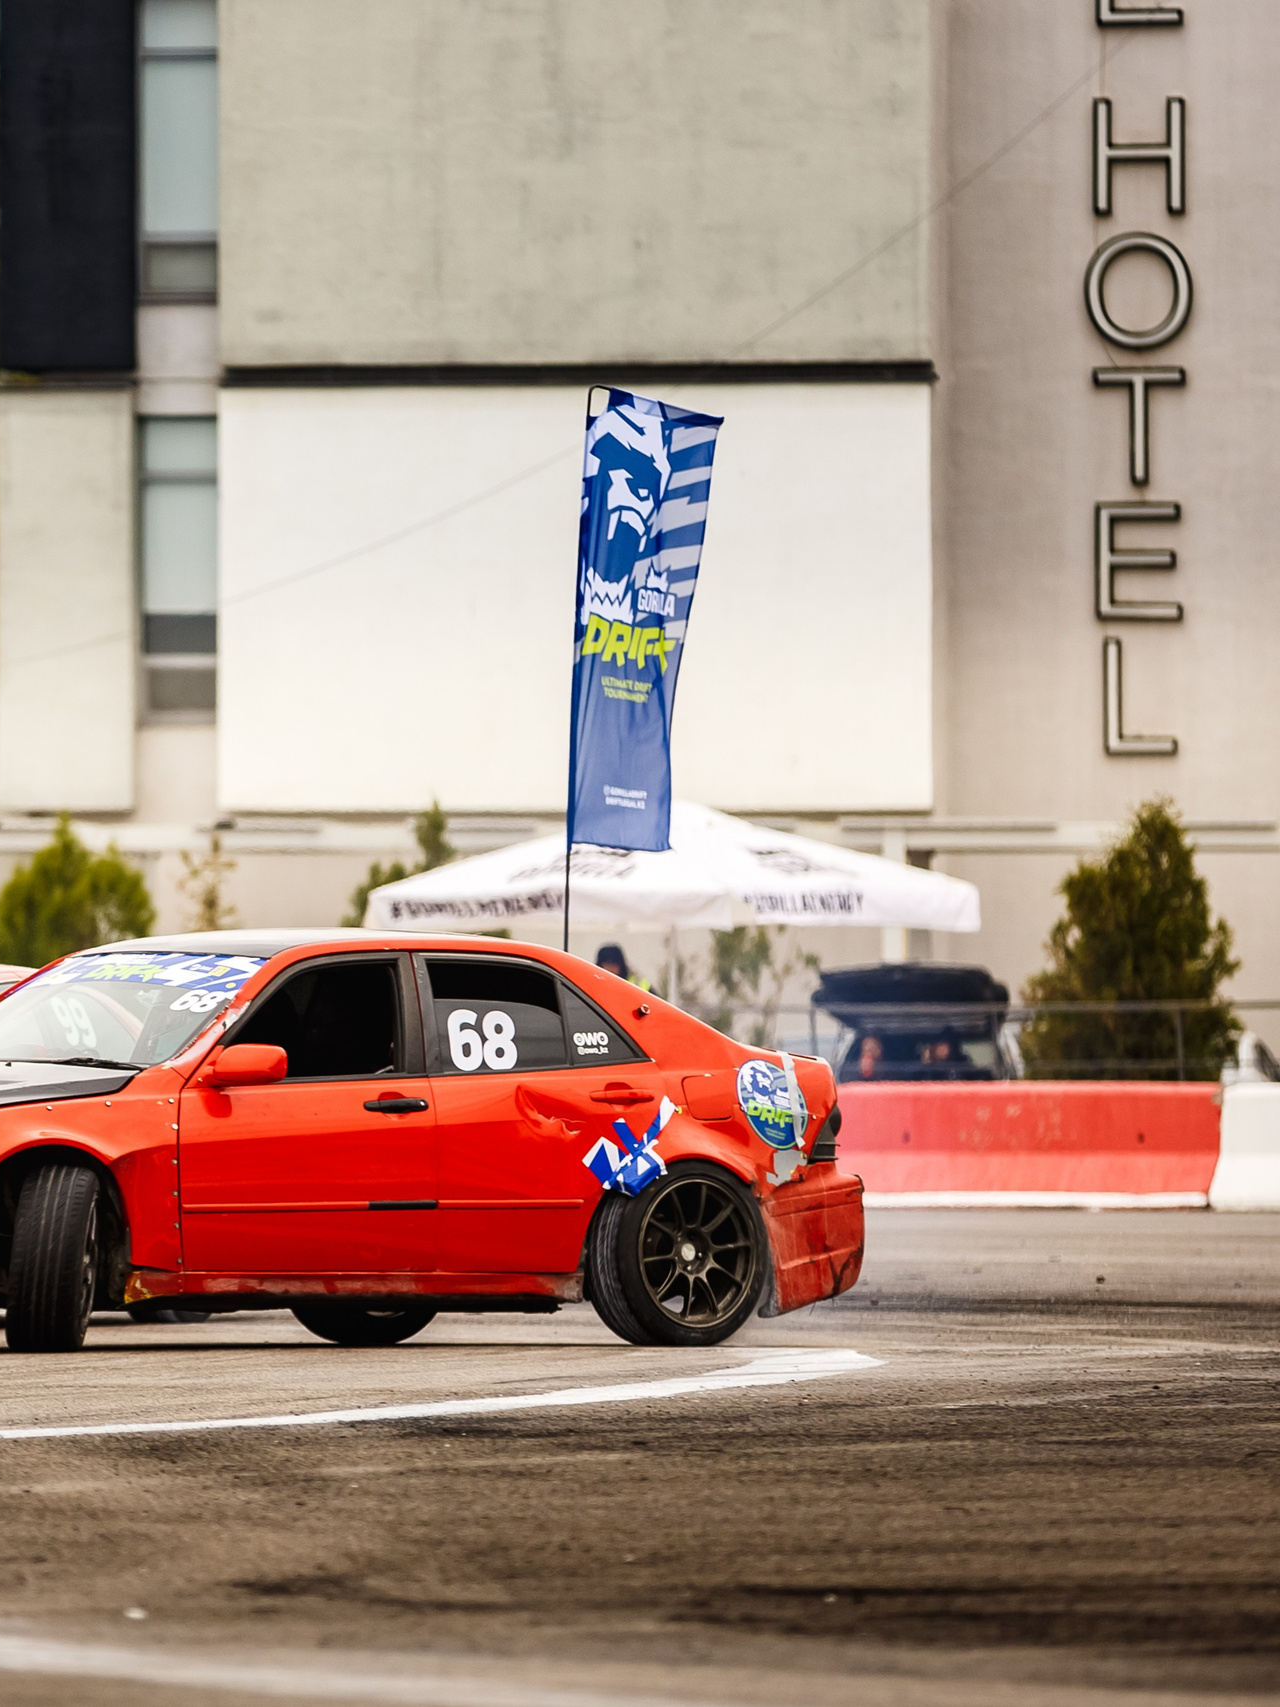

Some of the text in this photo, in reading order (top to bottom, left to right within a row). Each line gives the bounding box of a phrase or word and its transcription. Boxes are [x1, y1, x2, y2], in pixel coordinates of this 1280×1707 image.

[1084, 96, 1193, 757] HOTEL
[581, 613, 676, 676] DRIFT
[81, 963, 166, 983] DRIFT
[169, 988, 228, 1013] 68
[446, 1008, 519, 1072] 68
[747, 1098, 796, 1129] DRIF
